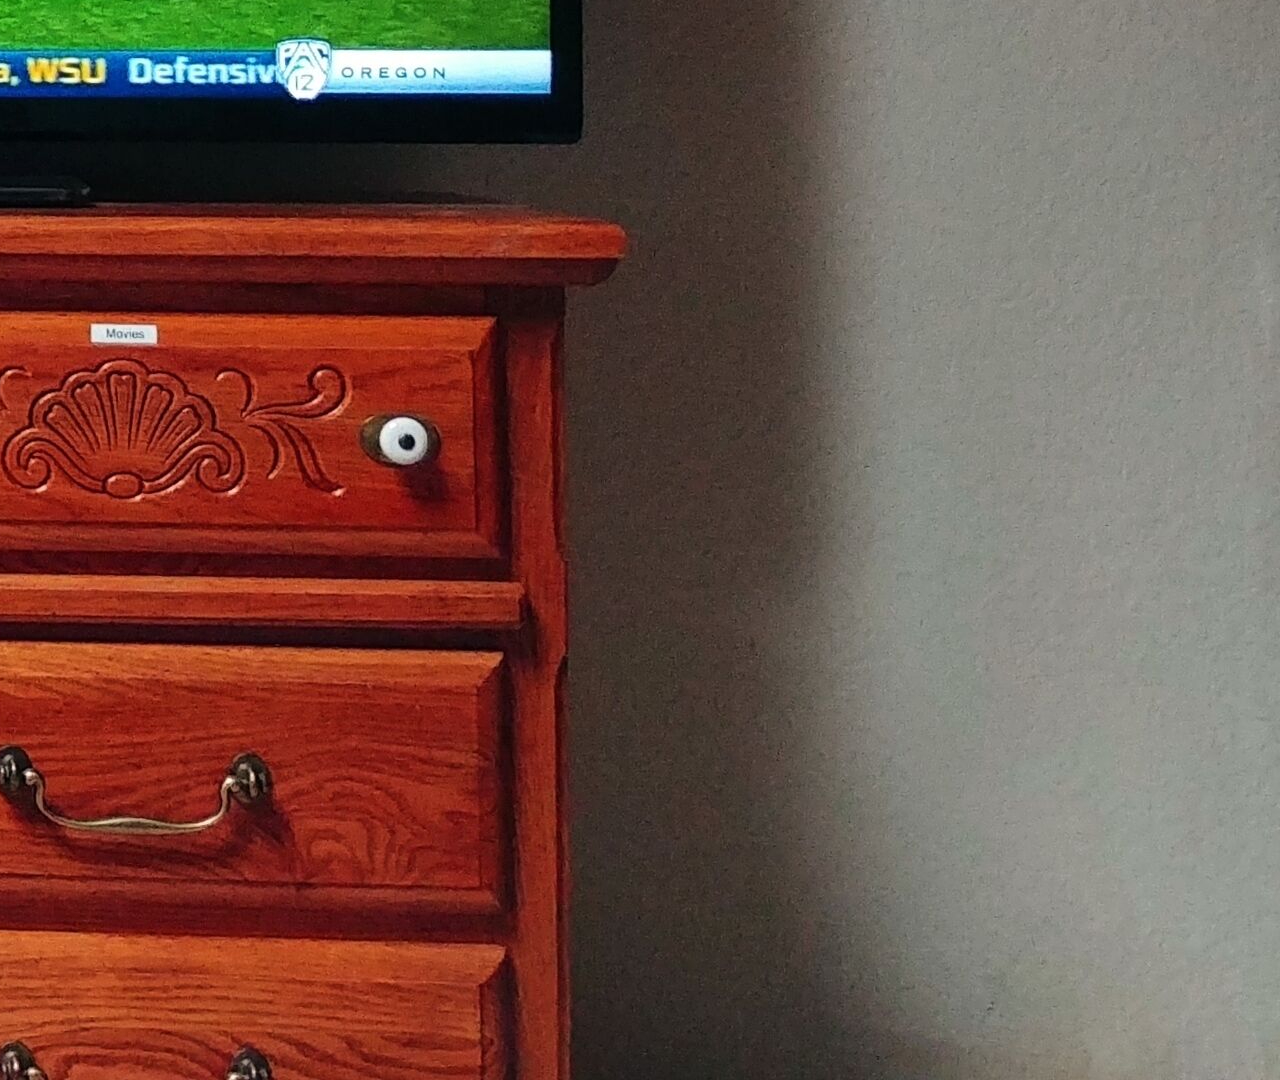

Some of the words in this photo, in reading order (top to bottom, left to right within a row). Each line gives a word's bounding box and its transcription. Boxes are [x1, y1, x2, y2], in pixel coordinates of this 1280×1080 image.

[28, 58, 106, 83] WSU
[128, 57, 282, 85] Defensiv
[342, 66, 446, 79] OREGON
[295, 74, 313, 90] 12
[106, 328, 145, 339] Movies
